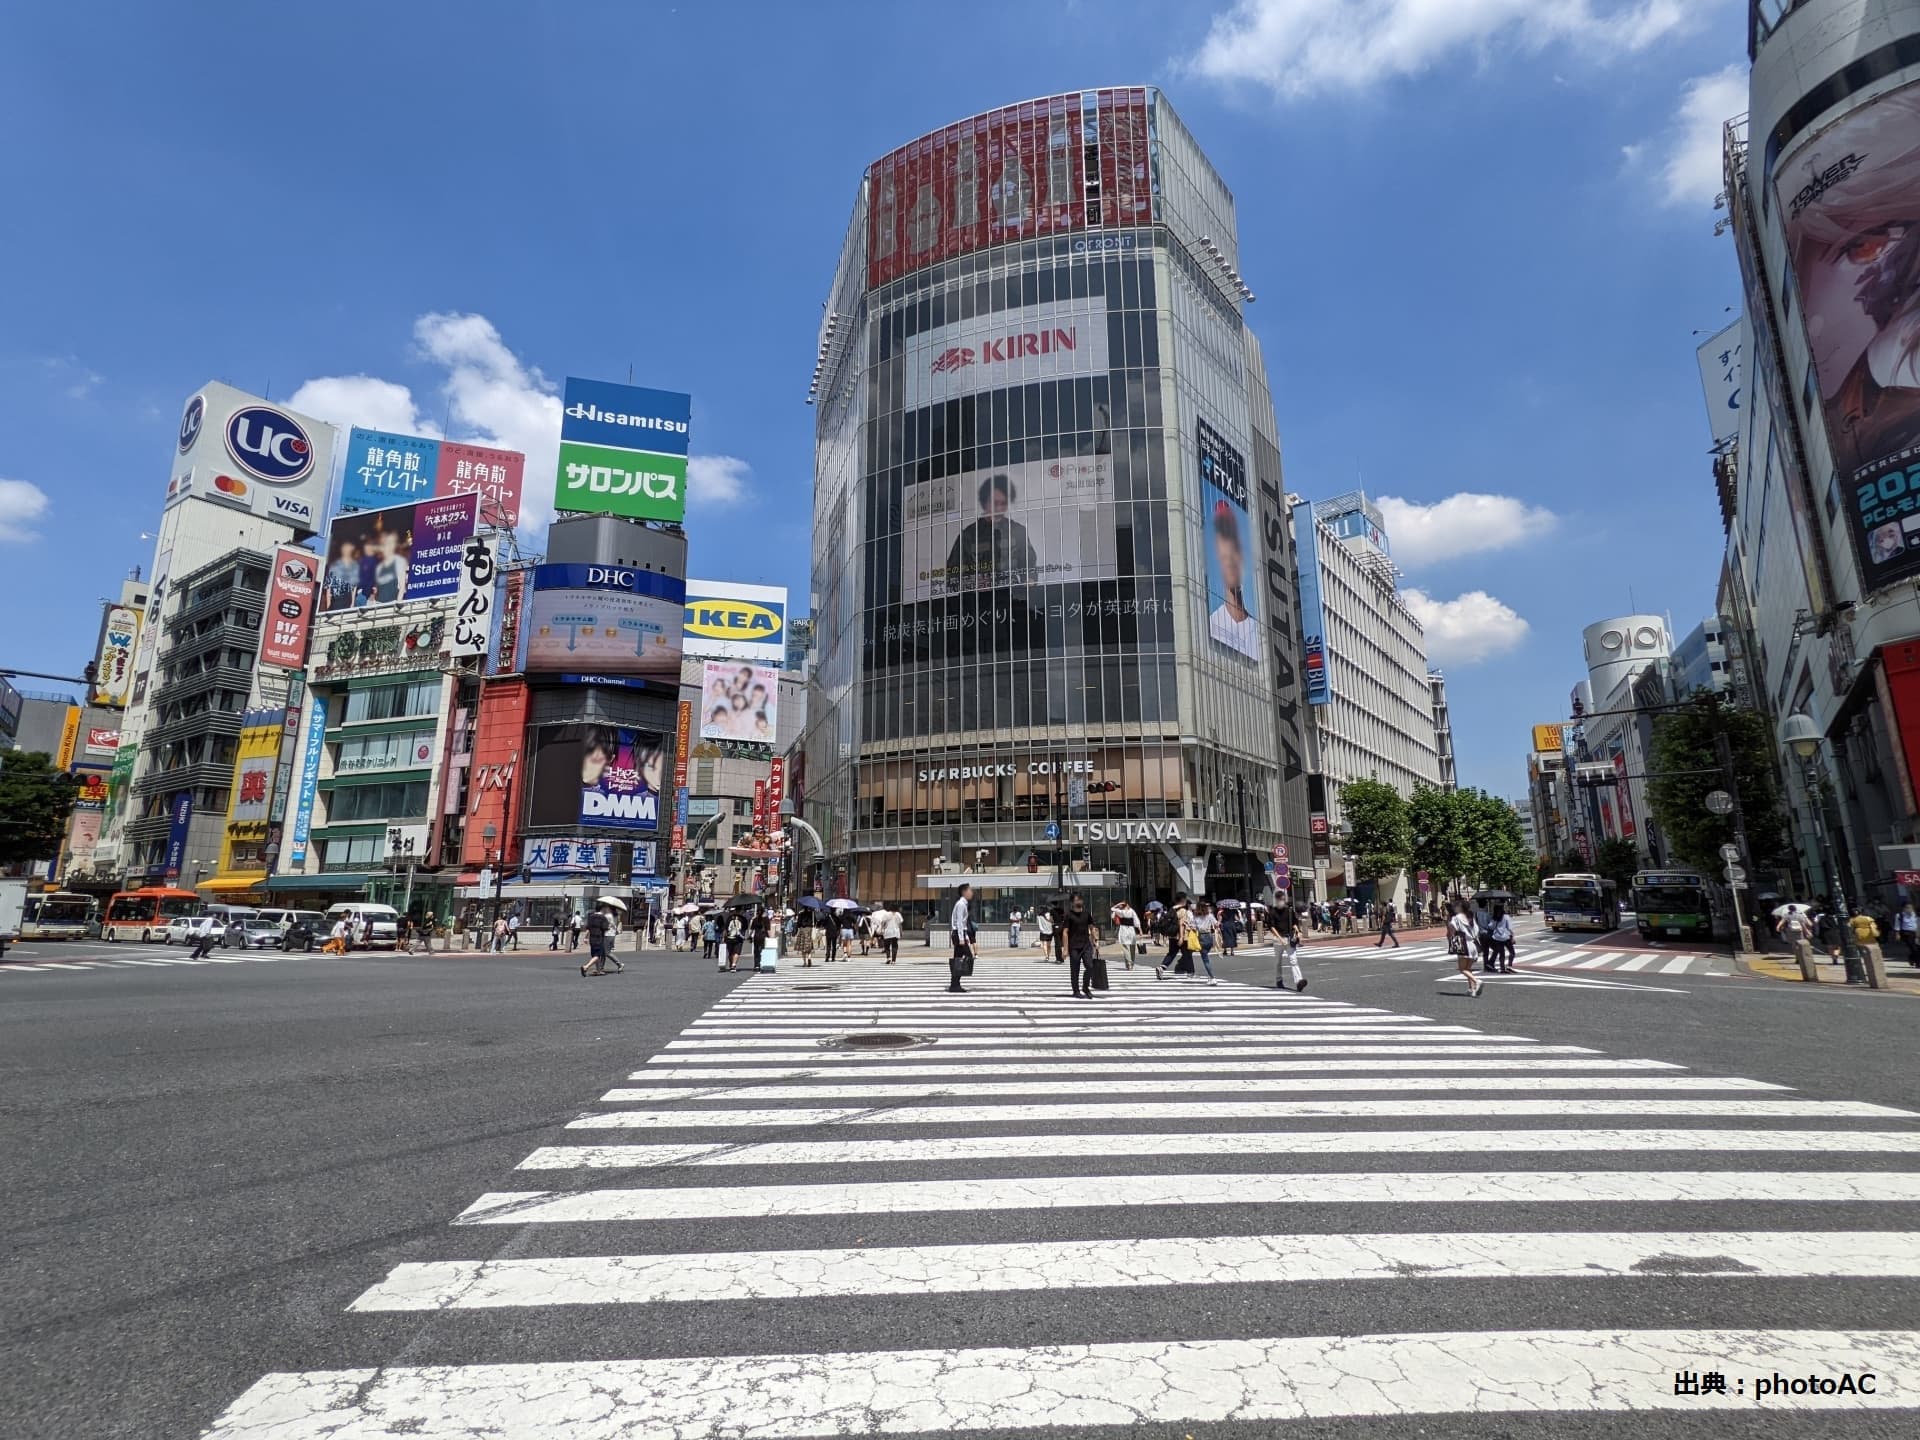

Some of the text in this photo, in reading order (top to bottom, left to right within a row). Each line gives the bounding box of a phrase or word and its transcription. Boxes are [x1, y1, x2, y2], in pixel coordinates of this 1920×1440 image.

[983, 326, 1076, 364] KIRIN
[566, 402, 687, 433] Hisamitsu
[237, 417, 304, 467] UC
[366, 446, 421, 472] 龍角散
[456, 460, 507, 483] 龍角散
[357, 466, 428, 492] ダイレクト
[565, 462, 677, 501] サロンパス
[1213, 464, 1233, 494] FTX
[273, 496, 310, 517] VISA
[417, 549, 428, 559] THE
[428, 546, 444, 557] BEAT
[588, 567, 635, 588] DHC
[455, 537, 493, 651] もんじゃ
[684, 608, 774, 630] IKEA
[1260, 479, 1303, 783] TSUTAYA
[1305, 634, 1327, 698] SEIBU
[581, 676, 626, 686] DHC Channel
[303, 714, 325, 799] サマーフルーツギフト
[770, 763, 782, 807] カラオケ
[918, 762, 1017, 782] STARBUCKS
[583, 791, 657, 820] DMM
[1073, 822, 1182, 842] TSUTAYA
